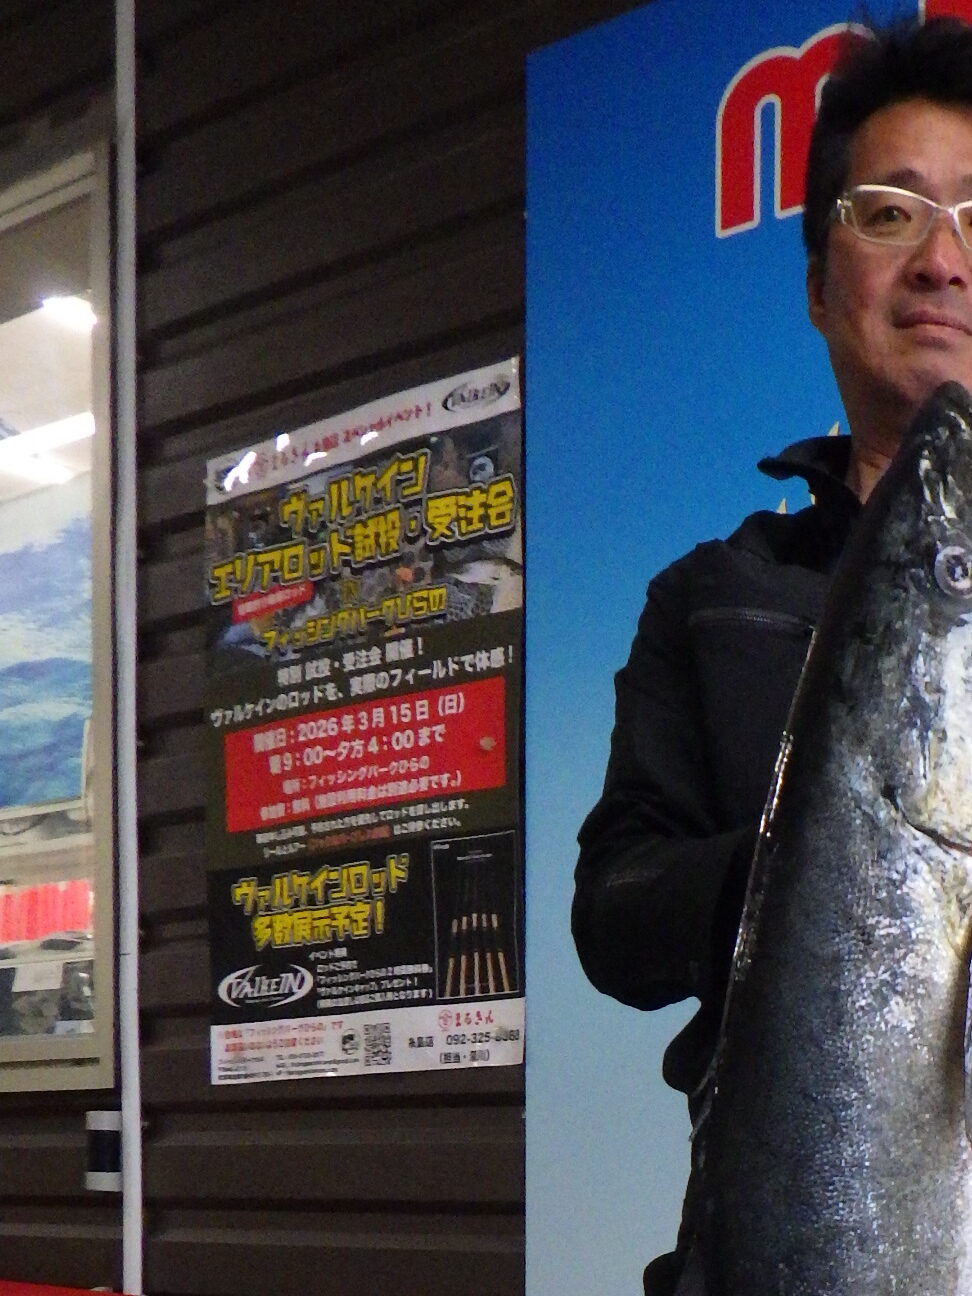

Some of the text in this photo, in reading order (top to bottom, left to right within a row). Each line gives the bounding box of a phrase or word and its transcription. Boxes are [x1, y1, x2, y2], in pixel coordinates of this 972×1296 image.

[232, 853, 409, 914] ヴァルケインロッド
[252, 899, 384, 950] 多数展示予定！
